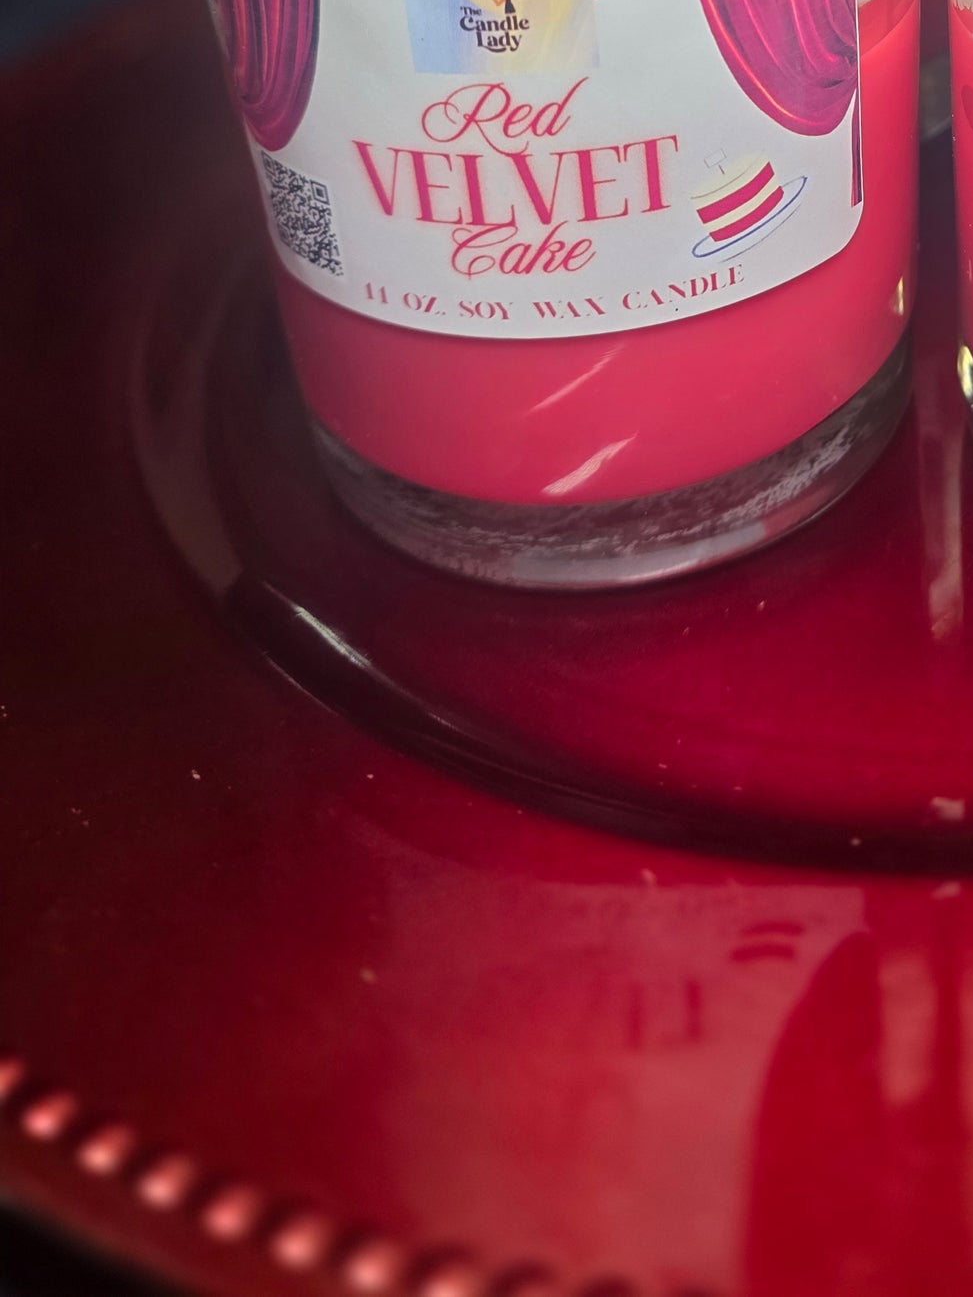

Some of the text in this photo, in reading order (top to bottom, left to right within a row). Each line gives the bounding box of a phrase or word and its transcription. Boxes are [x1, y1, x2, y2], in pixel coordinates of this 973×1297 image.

[459, 14, 530, 32] Candle
[460, 6, 483, 16] The
[476, 31, 522, 53] Lady
[421, 76, 590, 155] Red
[351, 134, 679, 226] VELVET
[451, 220, 597, 280] Cake
[459, 301, 514, 320] SOY
[532, 297, 607, 320] WAX
[622, 263, 746, 311] CANDLE
